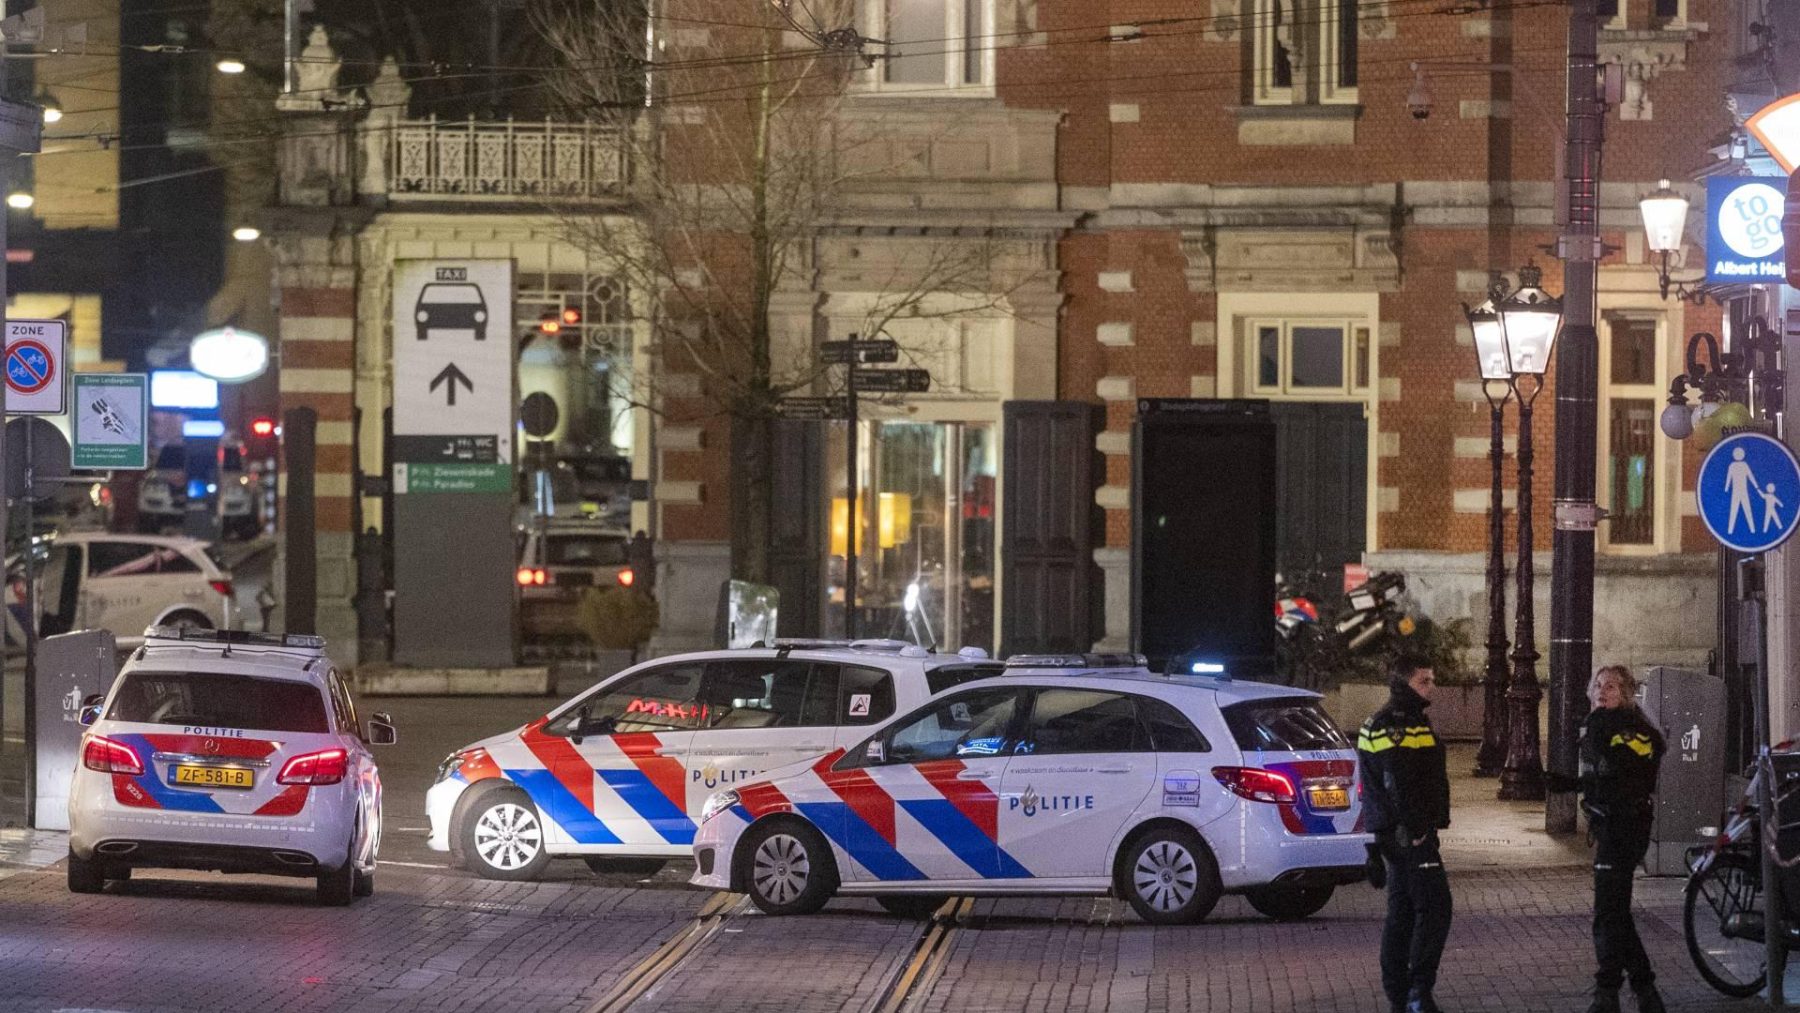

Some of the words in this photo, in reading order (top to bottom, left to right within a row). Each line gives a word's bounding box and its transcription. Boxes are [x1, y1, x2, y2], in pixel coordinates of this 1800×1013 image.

[1734, 195, 1769, 221] to
[1746, 214, 1781, 250] go
[438, 269, 466, 280] TAXI
[1714, 261, 1758, 275] Albert
[12, 326, 44, 335] ZONE
[475, 438, 494, 448] WC
[183, 726, 244, 738] POLITIE
[1310, 751, 1340, 759] POLITIE
[183, 769, 244, 784] ZF-581-B
[693, 770, 767, 789] POLIT
[1010, 795, 1094, 817] POLITIE
